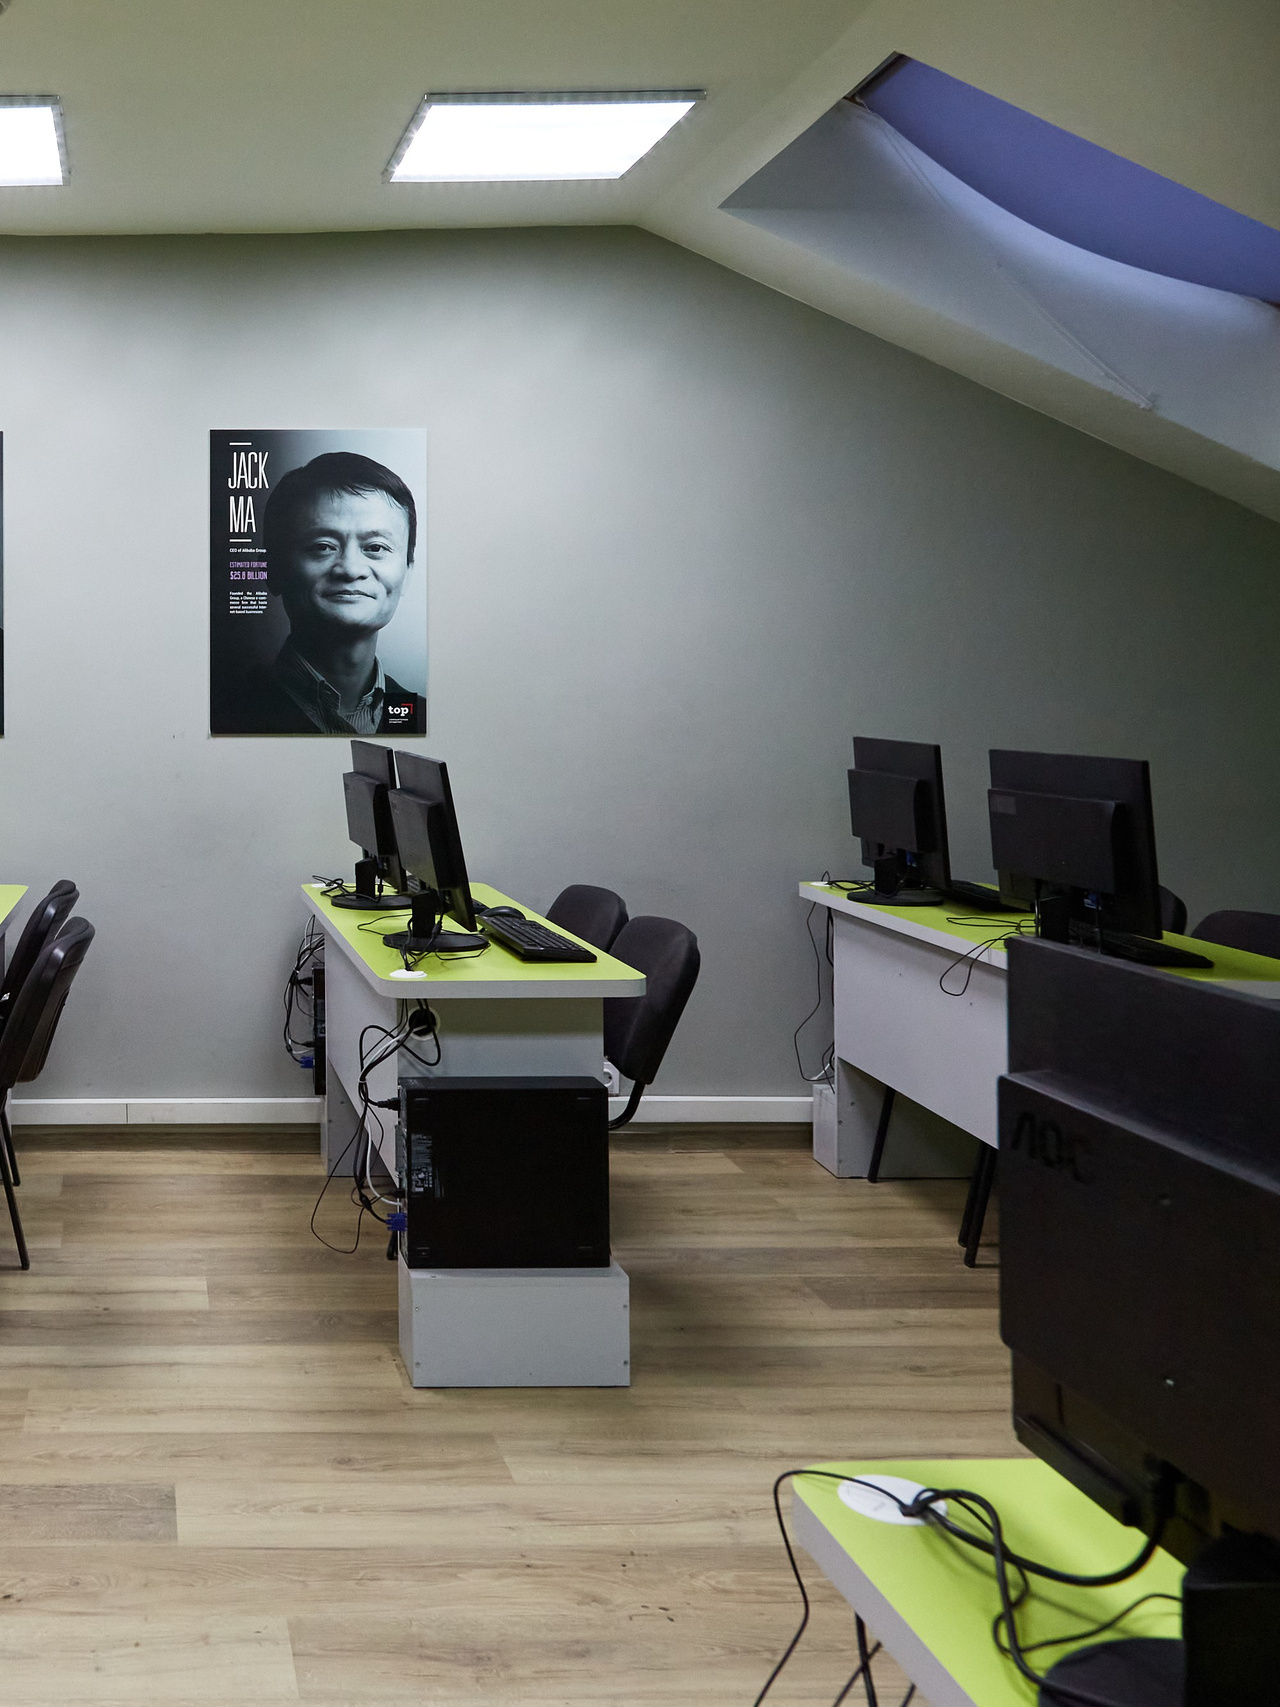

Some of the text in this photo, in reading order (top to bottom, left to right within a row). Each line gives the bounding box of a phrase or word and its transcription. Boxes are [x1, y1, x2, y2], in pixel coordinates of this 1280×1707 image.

[228, 452, 269, 489] JACK
[229, 496, 256, 532] MA
[230, 571, 268, 580] $25.8 BILLION
[388, 705, 409, 717] top
